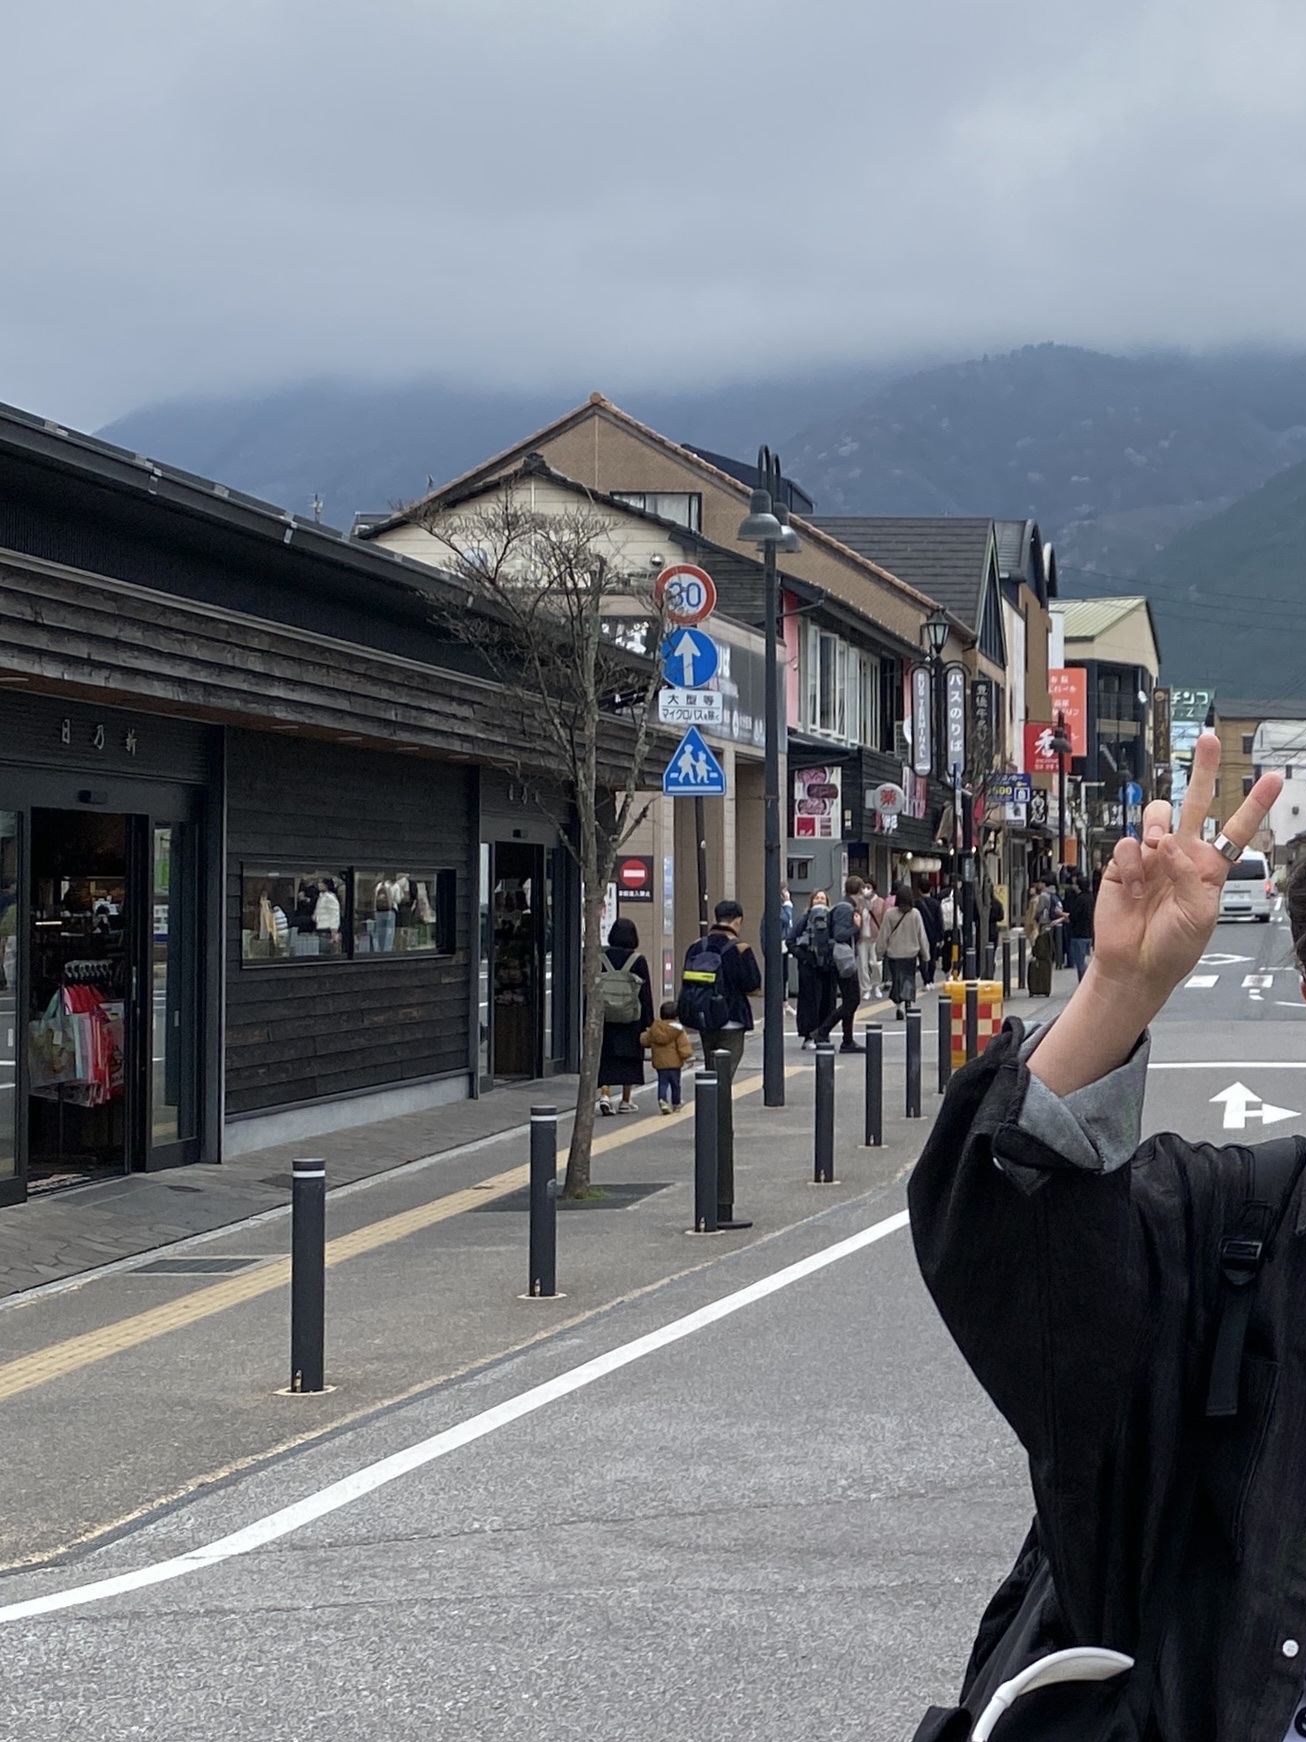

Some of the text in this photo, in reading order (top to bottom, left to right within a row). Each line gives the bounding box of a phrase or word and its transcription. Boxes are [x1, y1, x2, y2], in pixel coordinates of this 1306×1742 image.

[668, 582, 702, 609] 30
[668, 694, 715, 706] 大型等
[949, 674, 963, 752] バスのりば
